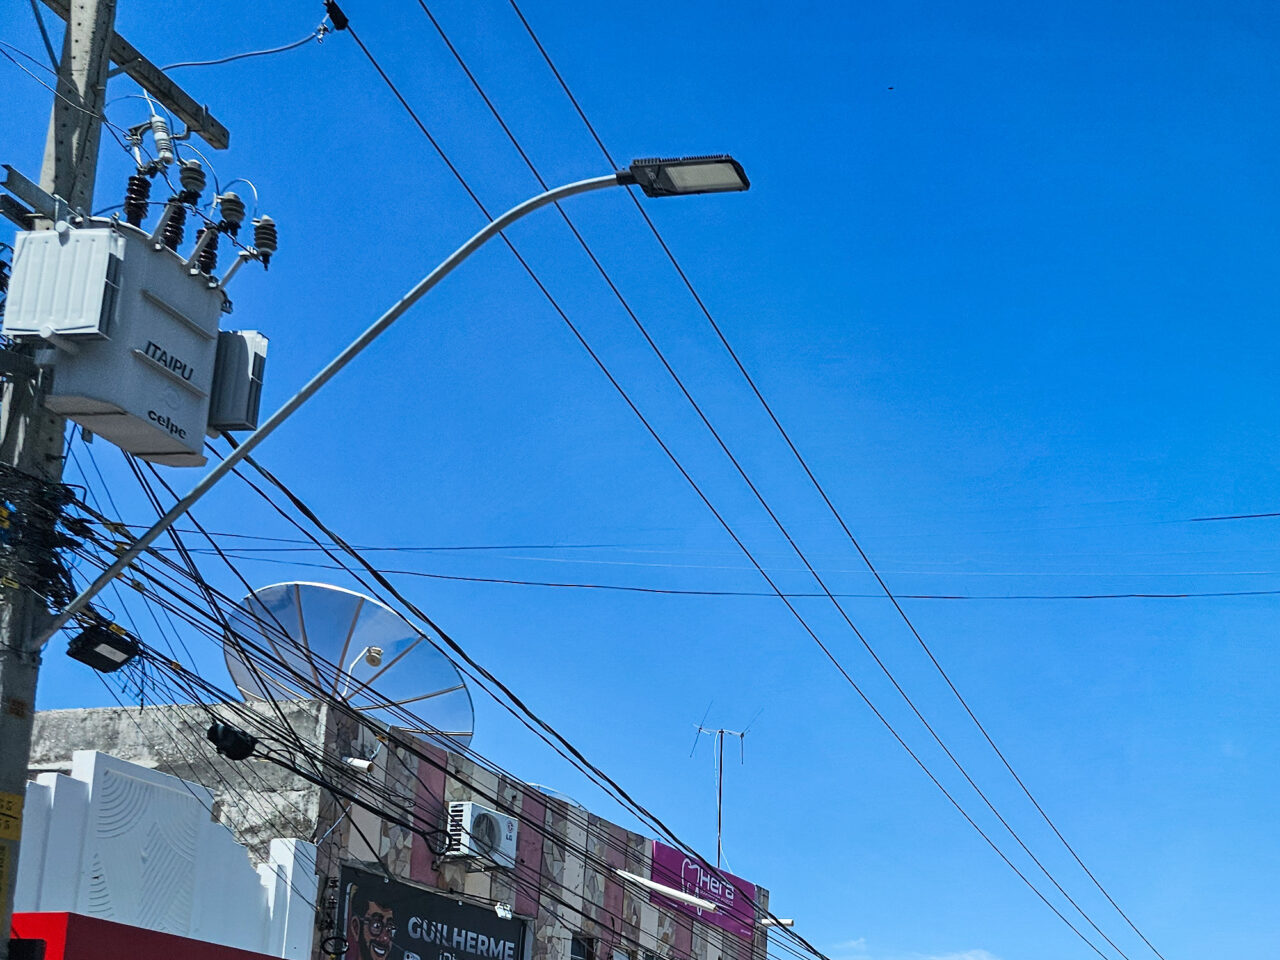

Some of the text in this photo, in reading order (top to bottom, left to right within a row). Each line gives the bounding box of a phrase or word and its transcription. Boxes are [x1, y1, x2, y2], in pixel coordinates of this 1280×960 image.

[145, 341, 193, 380] ITAIPU
[148, 410, 187, 439] celpe
[700, 868, 735, 900] Hera
